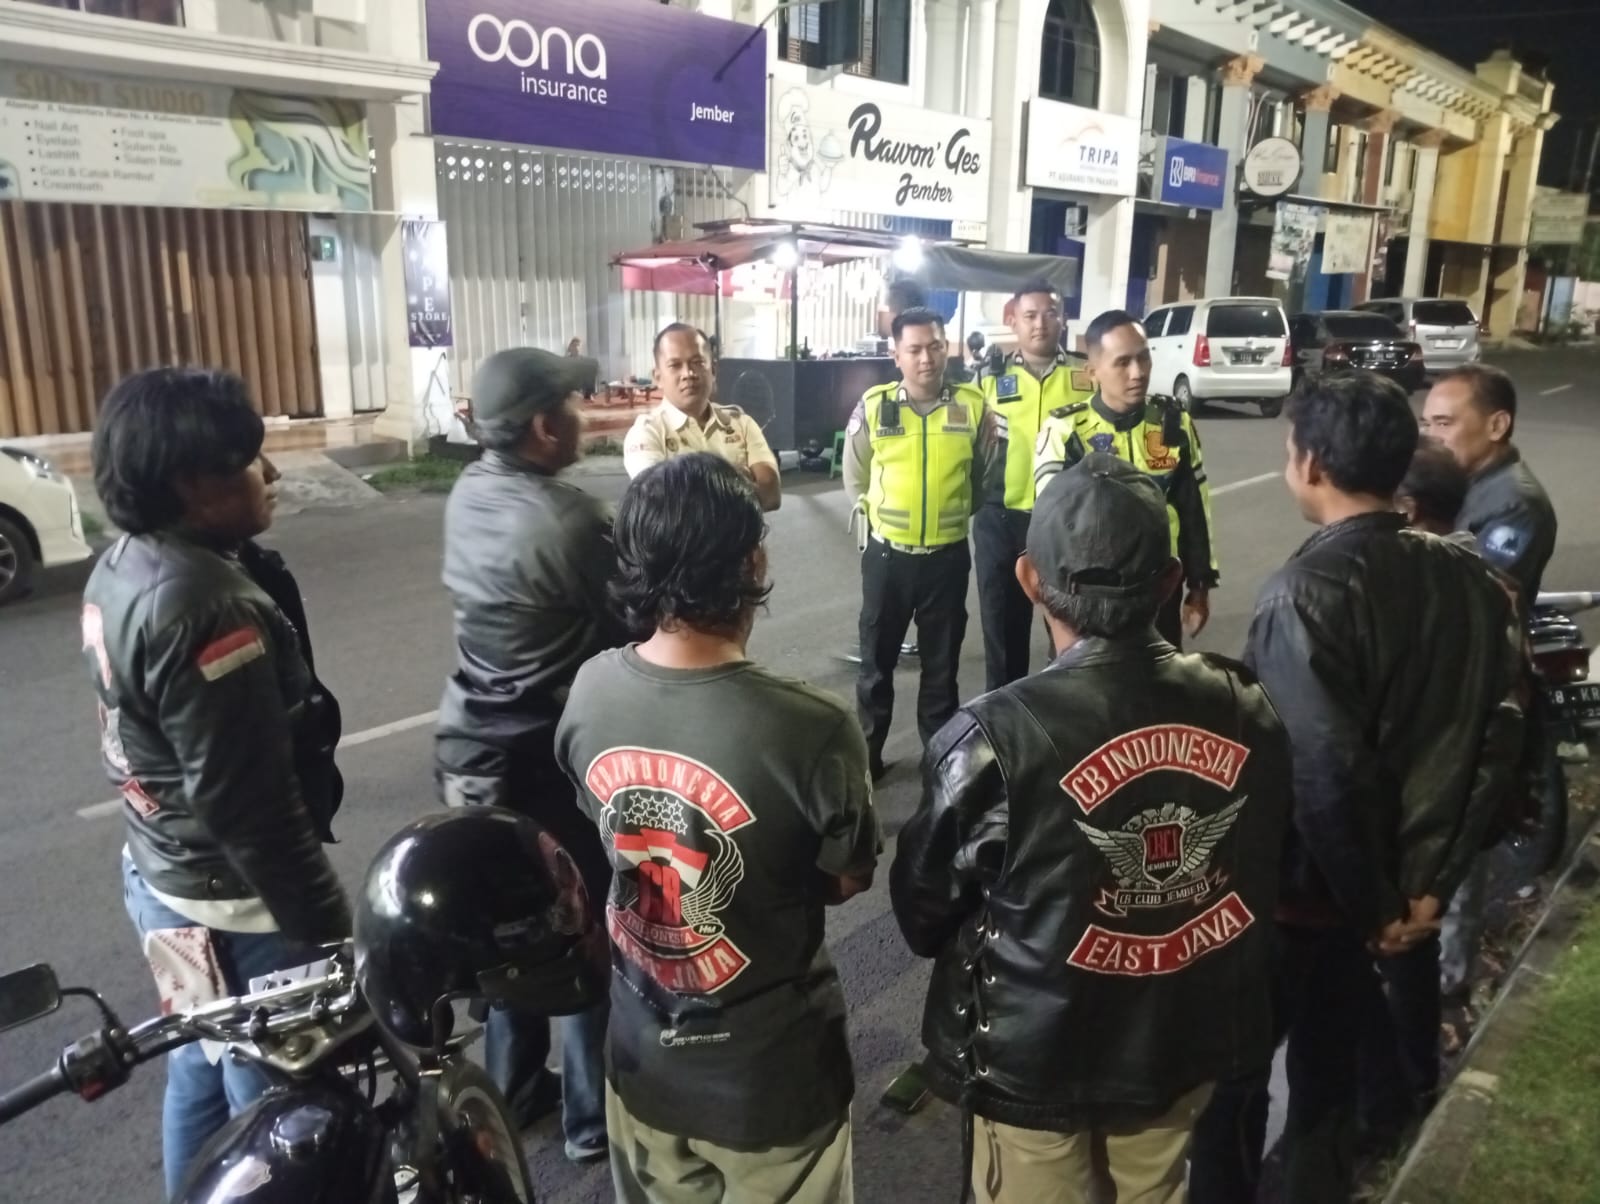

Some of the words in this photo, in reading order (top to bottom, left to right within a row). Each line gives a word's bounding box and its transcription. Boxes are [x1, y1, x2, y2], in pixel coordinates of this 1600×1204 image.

[467, 13, 607, 80] oona
[113, 83, 205, 115] STUDIO
[520, 71, 608, 105] insurance
[690, 102, 734, 123] Jember
[944, 128, 980, 175] Ges
[1079, 145, 1119, 167] TRIPA
[895, 172, 952, 206] Jember
[411, 312, 448, 322] STORE
[1071, 765, 1109, 804] CB
[1102, 732, 1237, 782] INDONESIA
[612, 755, 741, 824] INDONESIA
[1135, 892, 1162, 905] CLUB
[1166, 881, 1206, 903] JEMBER
[697, 924, 717, 937] HM
[1085, 937, 1169, 970] EAST
[1178, 908, 1243, 962] JAVA
[671, 946, 738, 989] JAVA
